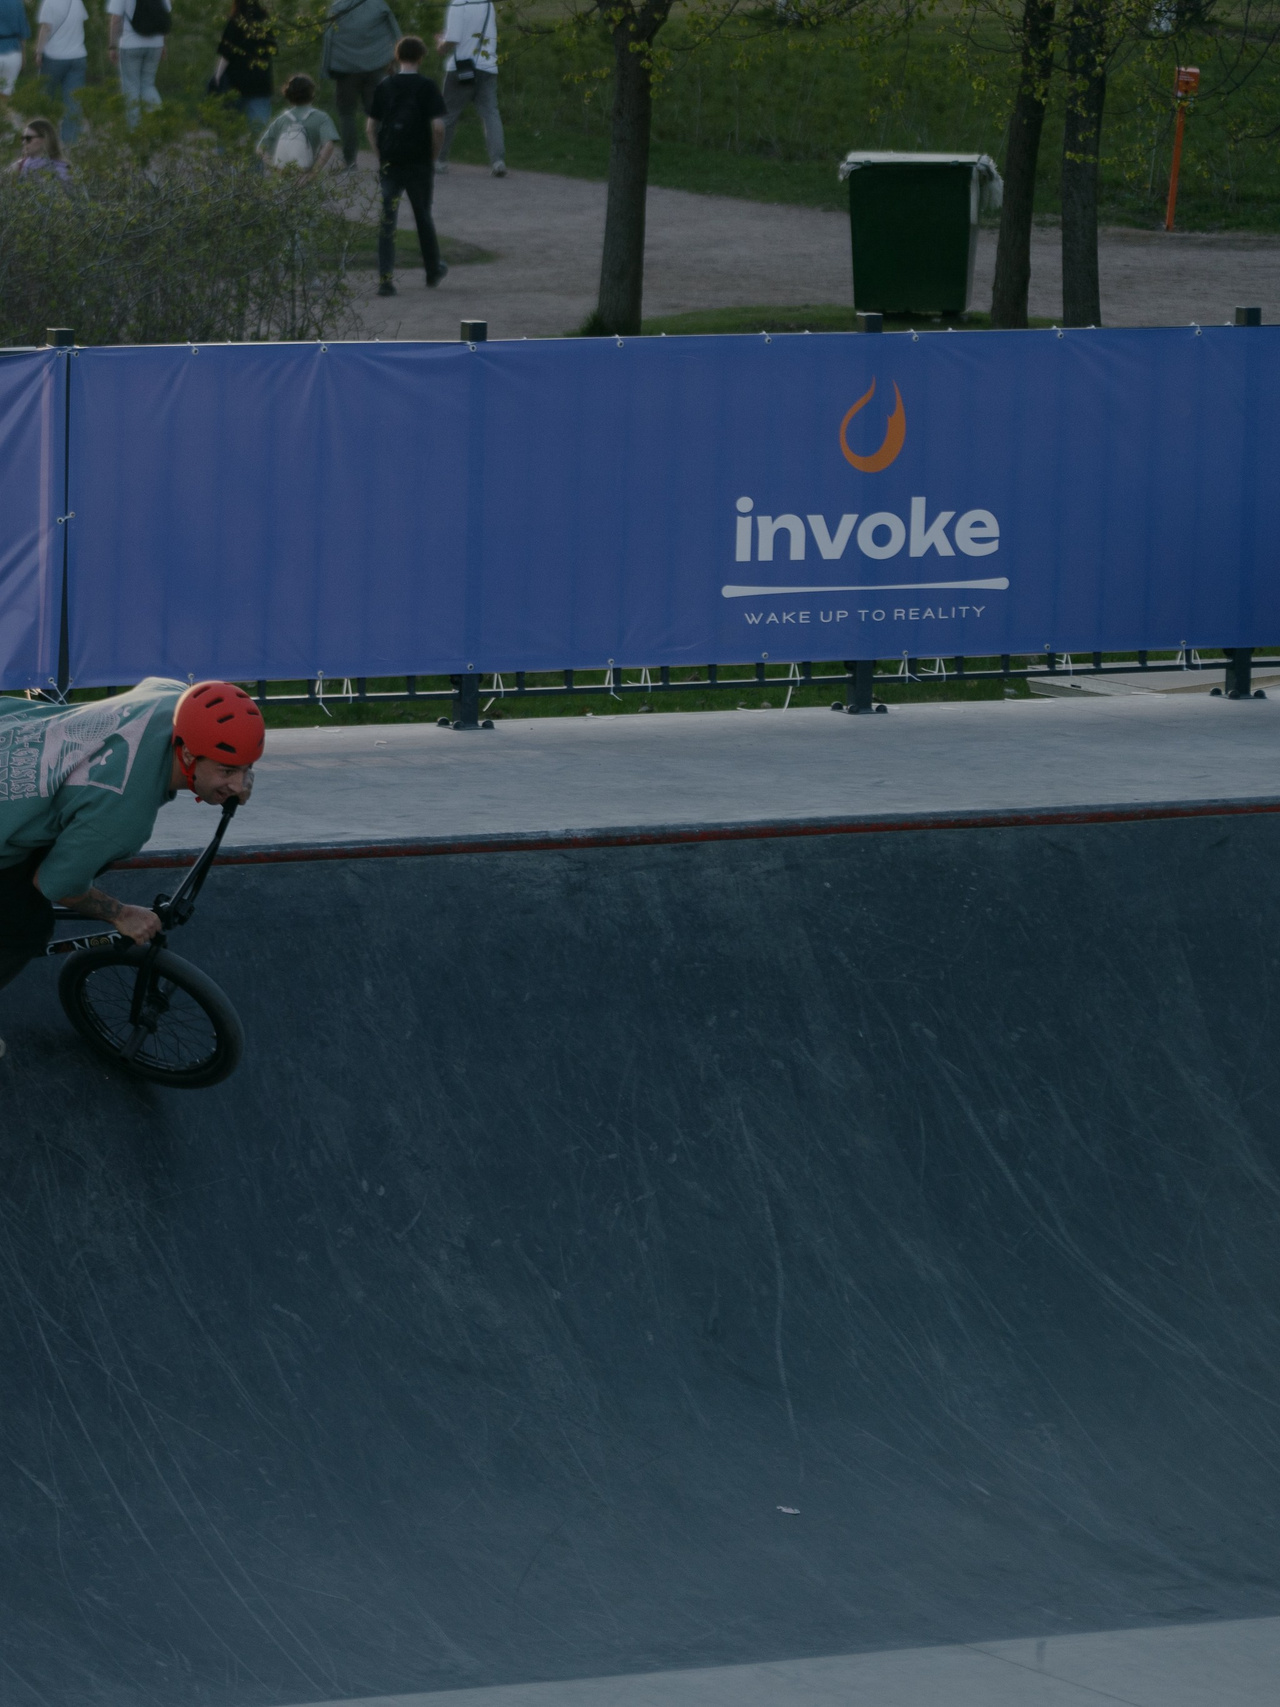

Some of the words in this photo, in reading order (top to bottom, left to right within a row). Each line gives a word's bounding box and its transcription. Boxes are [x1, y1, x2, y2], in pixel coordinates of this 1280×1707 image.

[735, 496, 1001, 562] invoke
[744, 611, 811, 625] WAKE
[819, 610, 849, 623] UP
[858, 609, 886, 622] TO
[893, 605, 987, 621] REALITY
